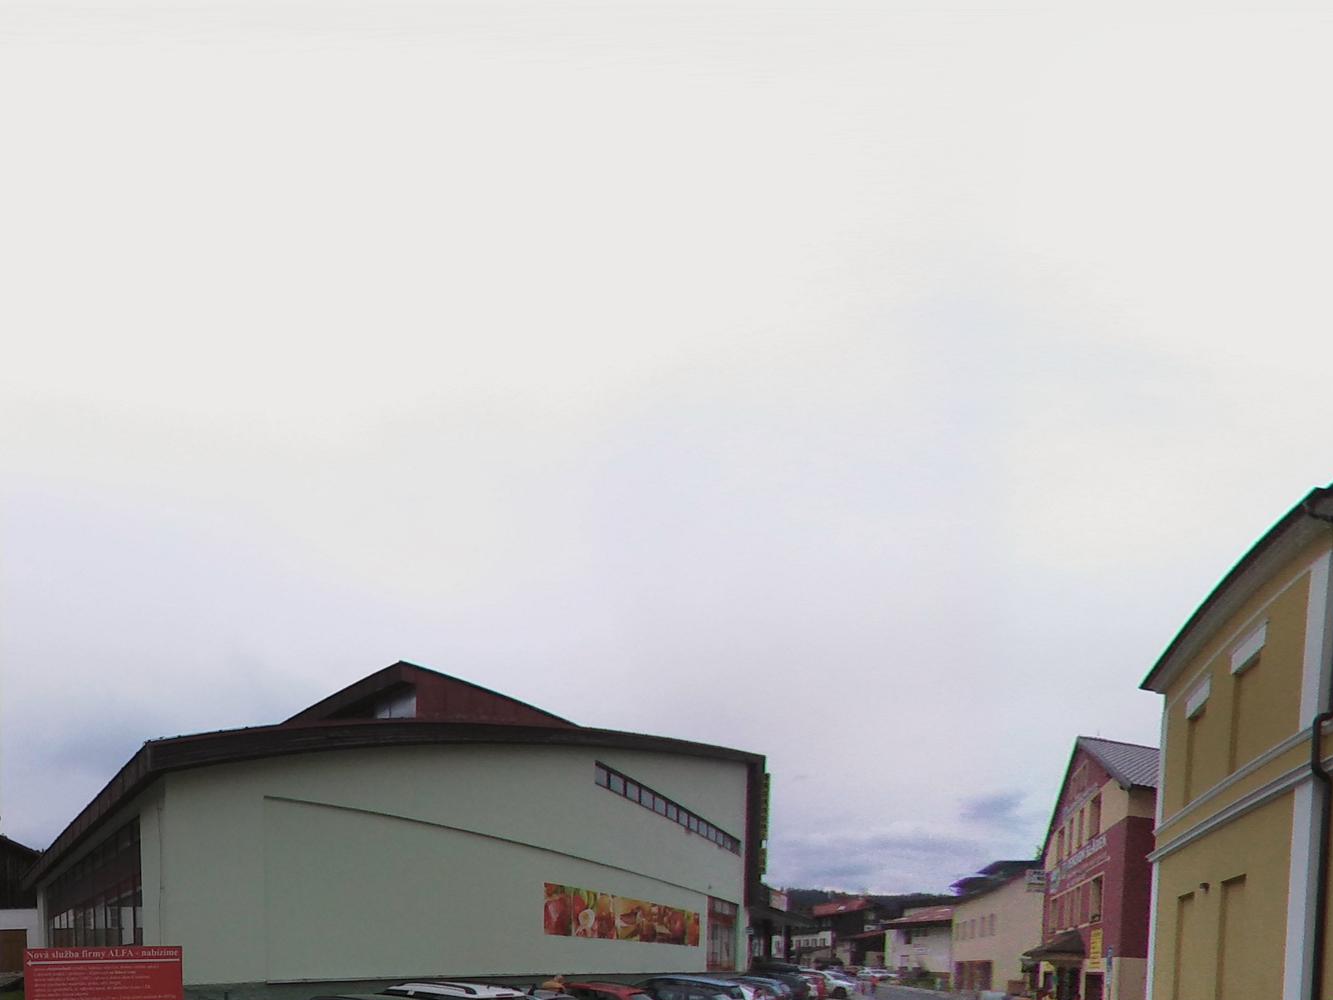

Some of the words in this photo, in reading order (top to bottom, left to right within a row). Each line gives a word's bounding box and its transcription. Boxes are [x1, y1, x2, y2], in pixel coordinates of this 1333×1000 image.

[27, 951, 49, 959] Nová
[51, 949, 80, 959] služba
[81, 949, 106, 960] firmy
[109, 949, 134, 958] ALFA
